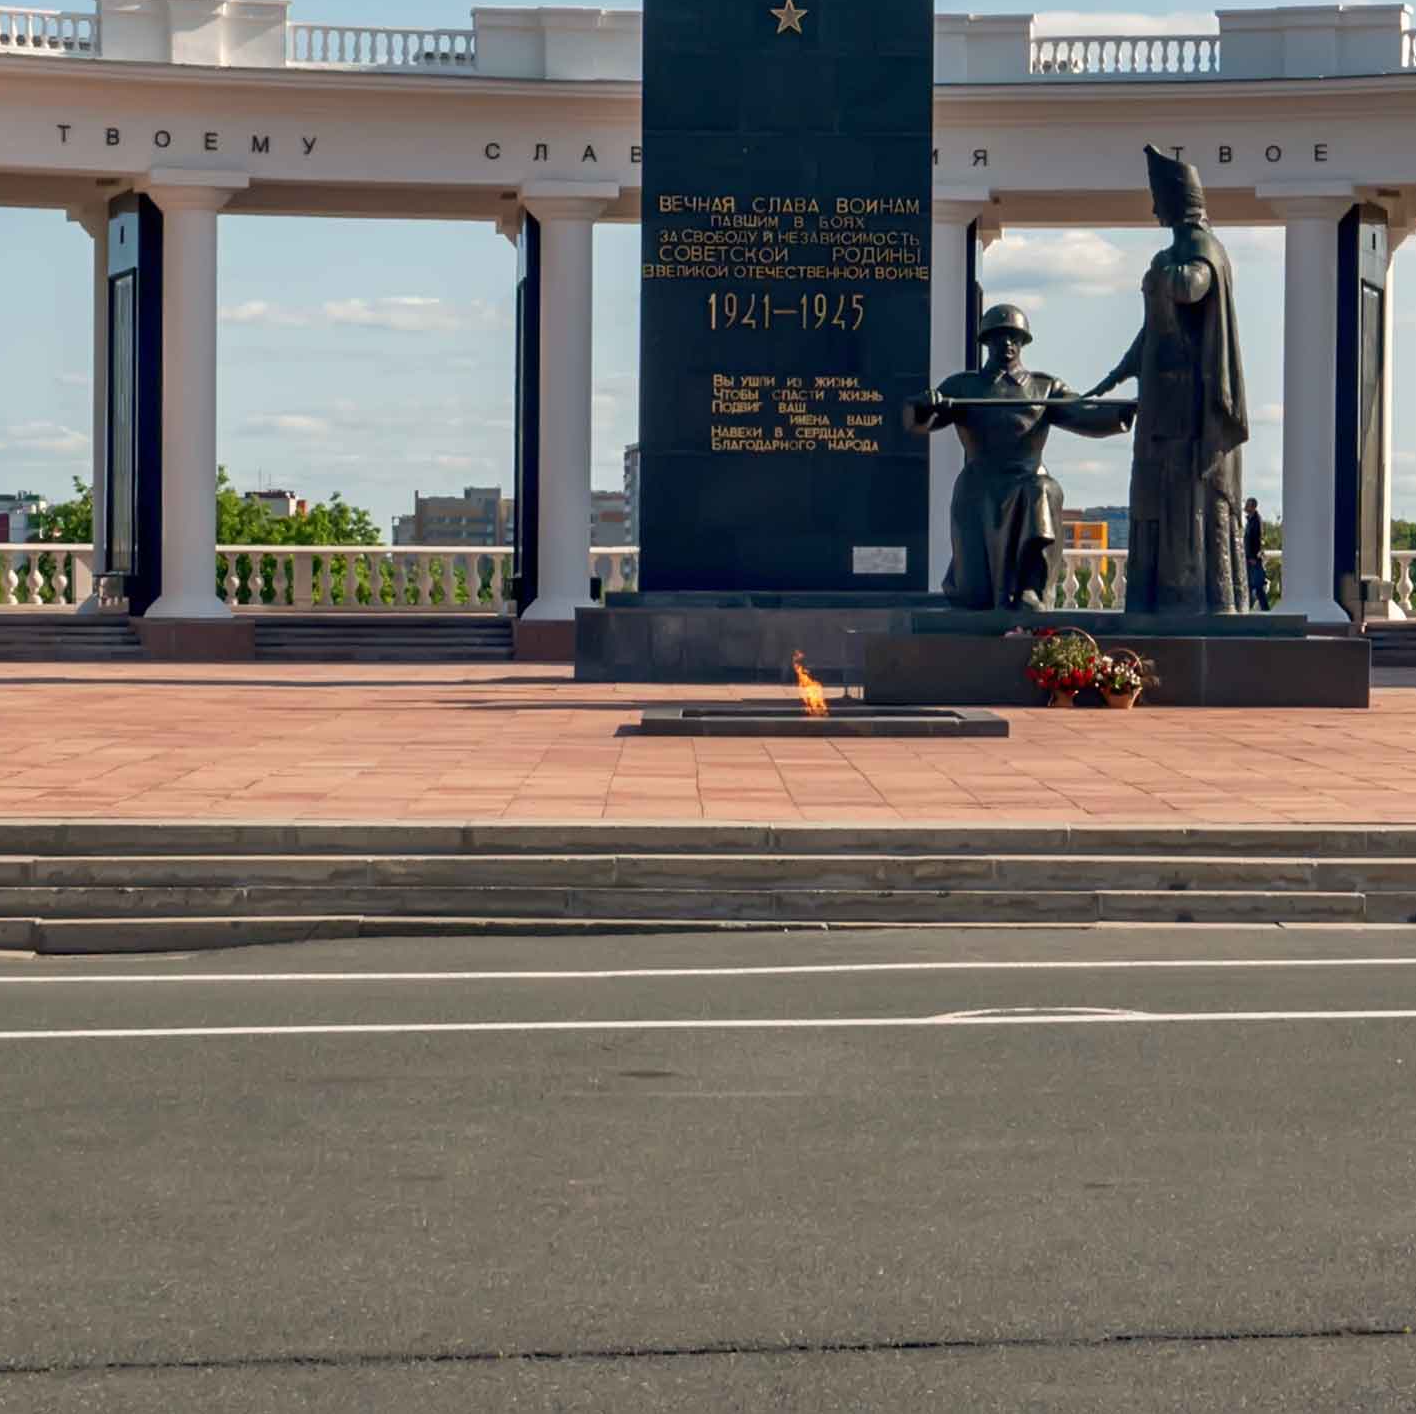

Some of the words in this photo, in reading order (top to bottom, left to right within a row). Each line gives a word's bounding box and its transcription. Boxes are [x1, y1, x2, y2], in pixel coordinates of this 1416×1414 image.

[57, 124, 317, 155] ТВОЕМУ
[1170, 143, 1328, 163] ТВОЕ
[658, 194, 735, 214] ВЕЧНАЯ
[751, 195, 820, 214] СЛАВА
[835, 196, 920, 215] ВОИНАМ
[710, 214, 779, 228] ПАВШИМ
[793, 215, 805, 228] В
[818, 215, 865, 229] БОЯХ
[659, 229, 678, 243] ЗА
[681, 228, 759, 244] СВОБОДУ
[777, 230, 920, 246] НЕЗАВИСИМОСТЬ
[831, 247, 921, 266] РОДИНЫ
[790, 413, 831, 426] ИМЕНА
[794, 426, 856, 441] СЕРДЦАХ
[827, 439, 880, 454] НАРОДА
